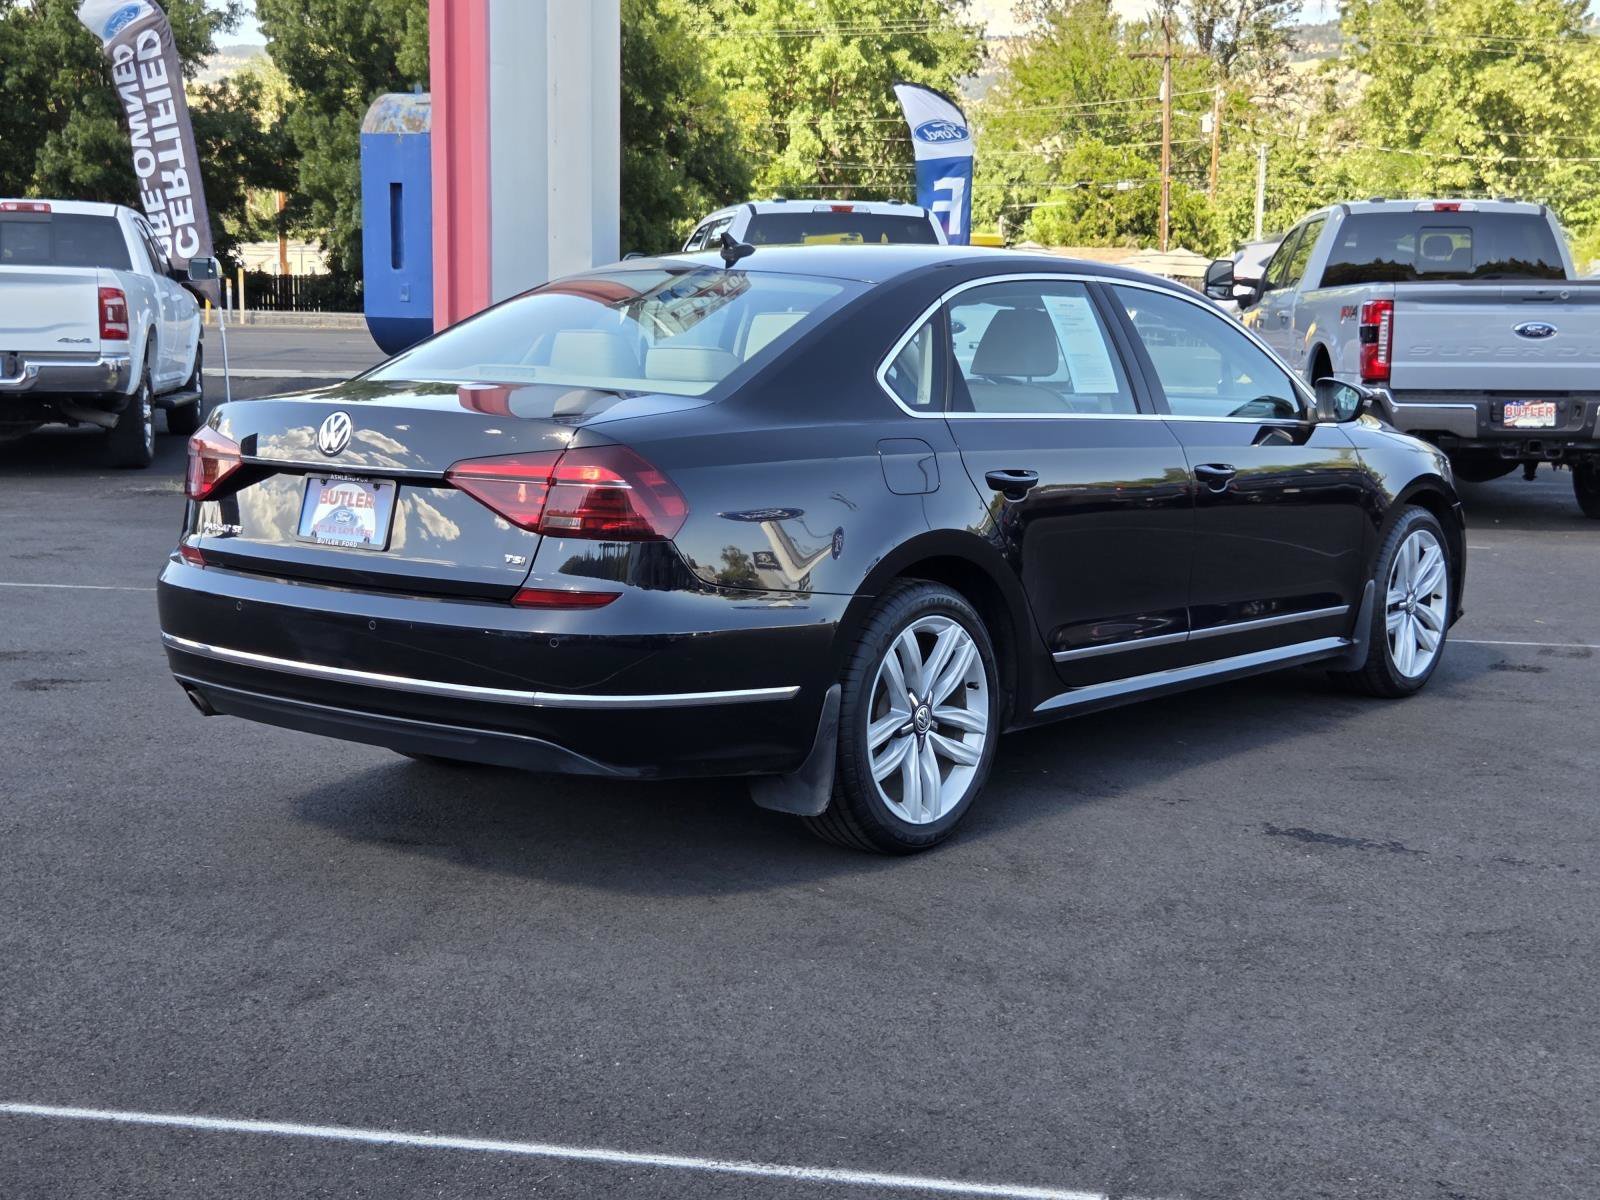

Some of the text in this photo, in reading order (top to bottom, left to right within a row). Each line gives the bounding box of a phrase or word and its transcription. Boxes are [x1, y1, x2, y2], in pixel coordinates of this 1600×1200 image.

[1408, 345, 1546, 357] SUPER
[1505, 406, 1554, 417] BUTLER
[319, 488, 374, 509] BUTLER
[317, 537, 359, 548] BUTLER FORD
